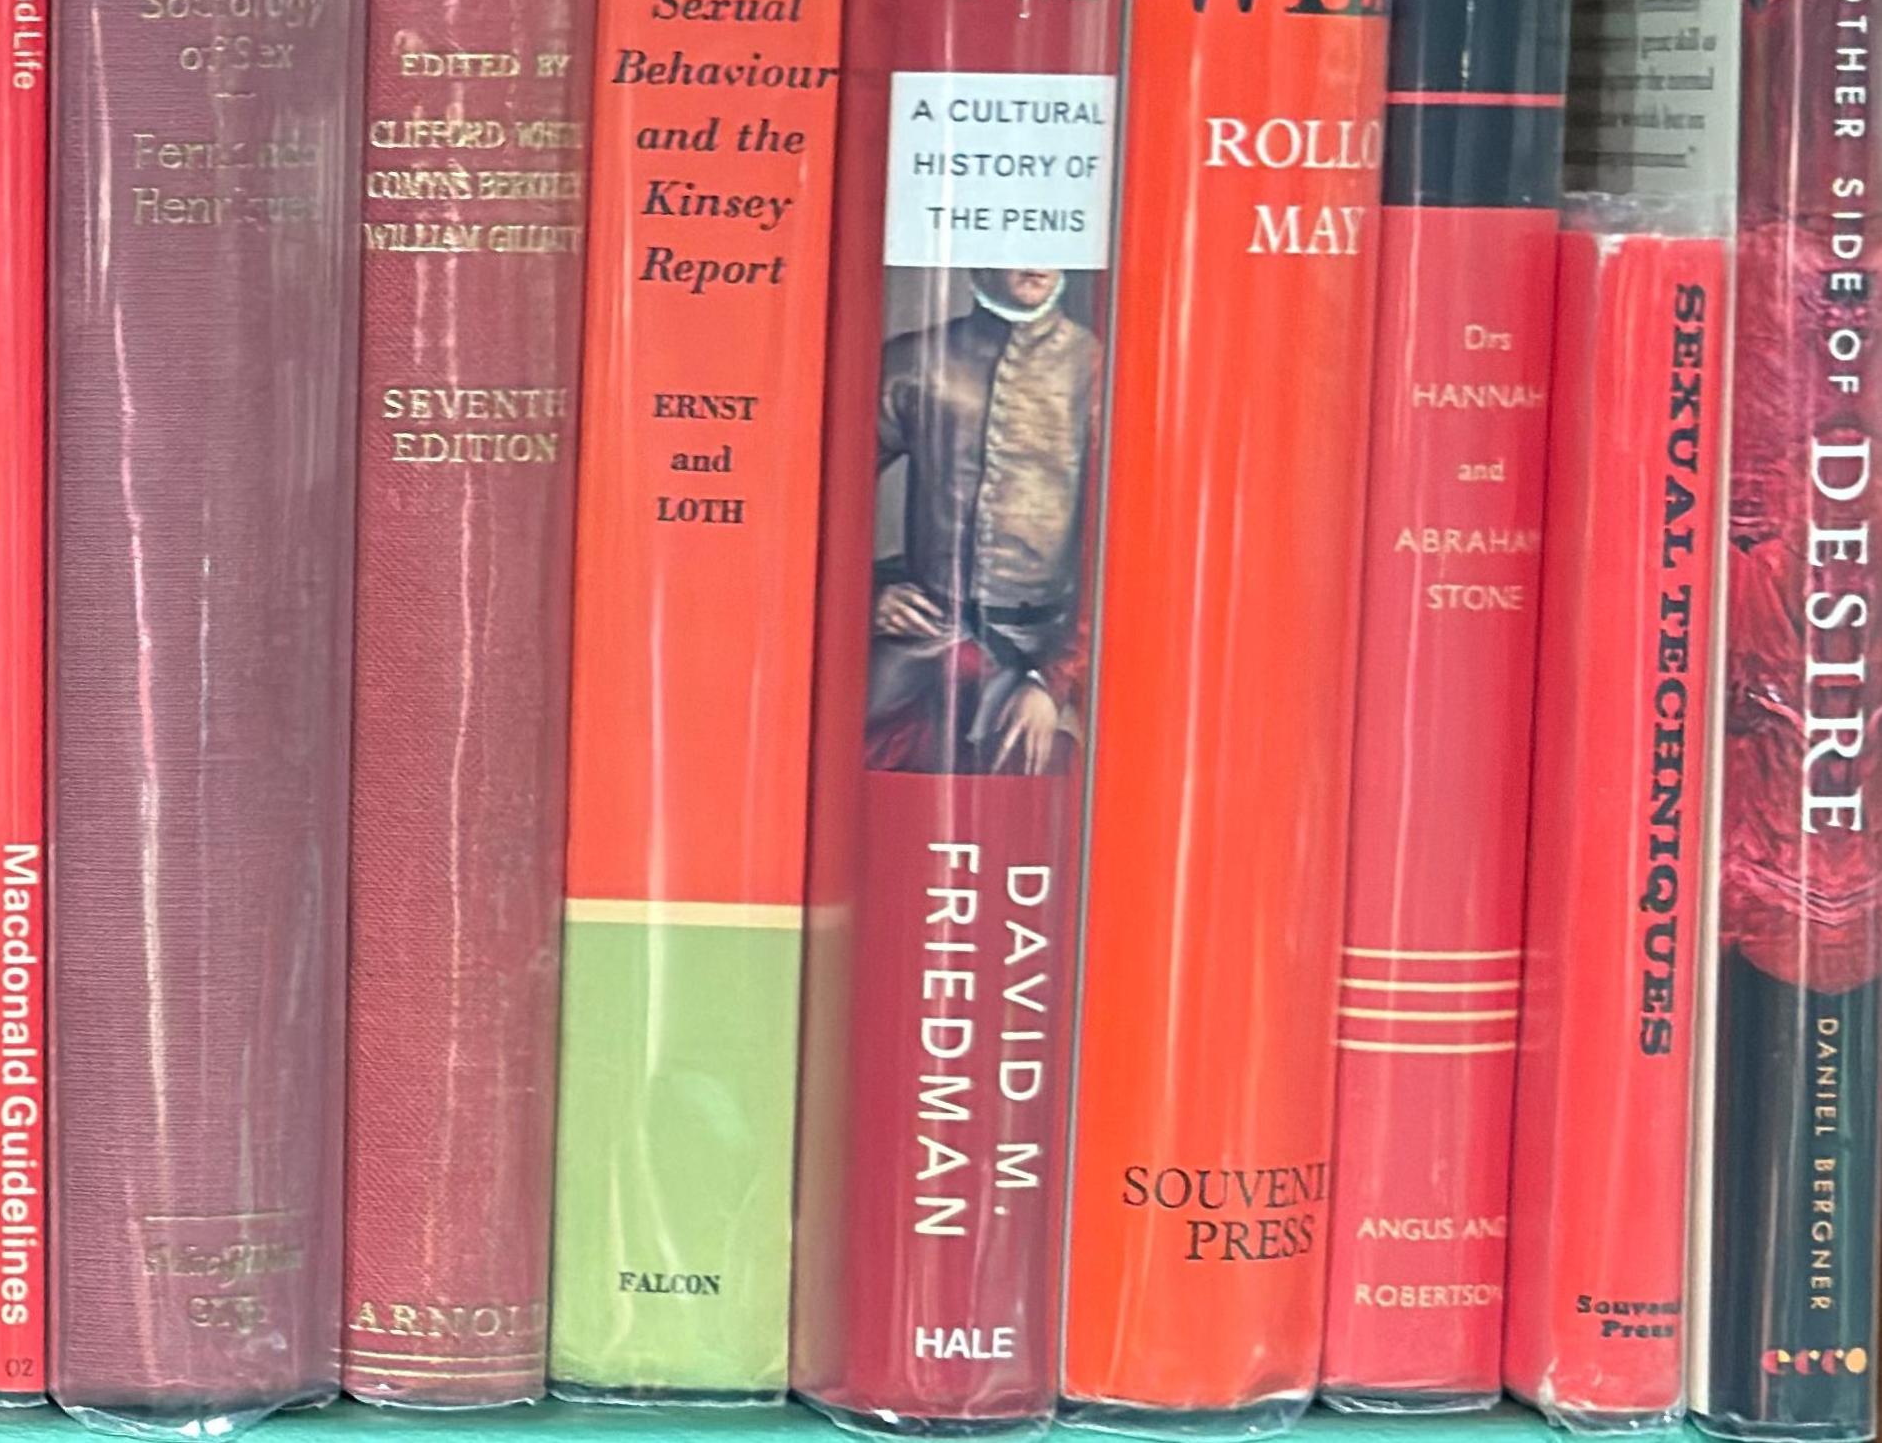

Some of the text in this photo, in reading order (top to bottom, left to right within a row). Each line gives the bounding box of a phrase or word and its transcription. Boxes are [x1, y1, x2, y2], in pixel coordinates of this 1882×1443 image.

[13, 30, 44, 91] Life
[613, 50, 839, 89] Behaviour
[912, 99, 1106, 125] A CULTURAL
[637, 118, 804, 153] and the
[913, 153, 1098, 178] HISTORY OF
[641, 182, 794, 230] Kinsey
[927, 208, 1086, 232] THE PENIS
[1248, 205, 1366, 256] MAY
[1830, 177, 1863, 293] SIDE
[639, 247, 787, 295] Report
[1463, 325, 1512, 351] Drs
[1829, 329, 1860, 395] OF
[382, 389, 566, 419] SEVENTH
[653, 395, 758, 420] ERNST
[392, 434, 558, 463] EDITION
[671, 447, 731, 473] and
[658, 499, 744, 523] LOTH
[1426, 585, 1524, 610] STONE
[1802, 435, 1870, 835] DESIRE
[1640, 283, 1707, 1057] SEXUAL TECHNIQUES
[915, 842, 980, 1237] FRIEDMAN
[994, 866, 1050, 1217] DAVID M.
[0, 843, 39, 1326] Macdonald Guidelines
[1810, 1018, 1839, 1311] DANIEL BERGNER
[1185, 1215, 1316, 1261] PRESS
[1357, 1217, 1453, 1241] ANGUS
[619, 1273, 720, 1295] FALCON
[915, 1328, 1015, 1359] HALE
